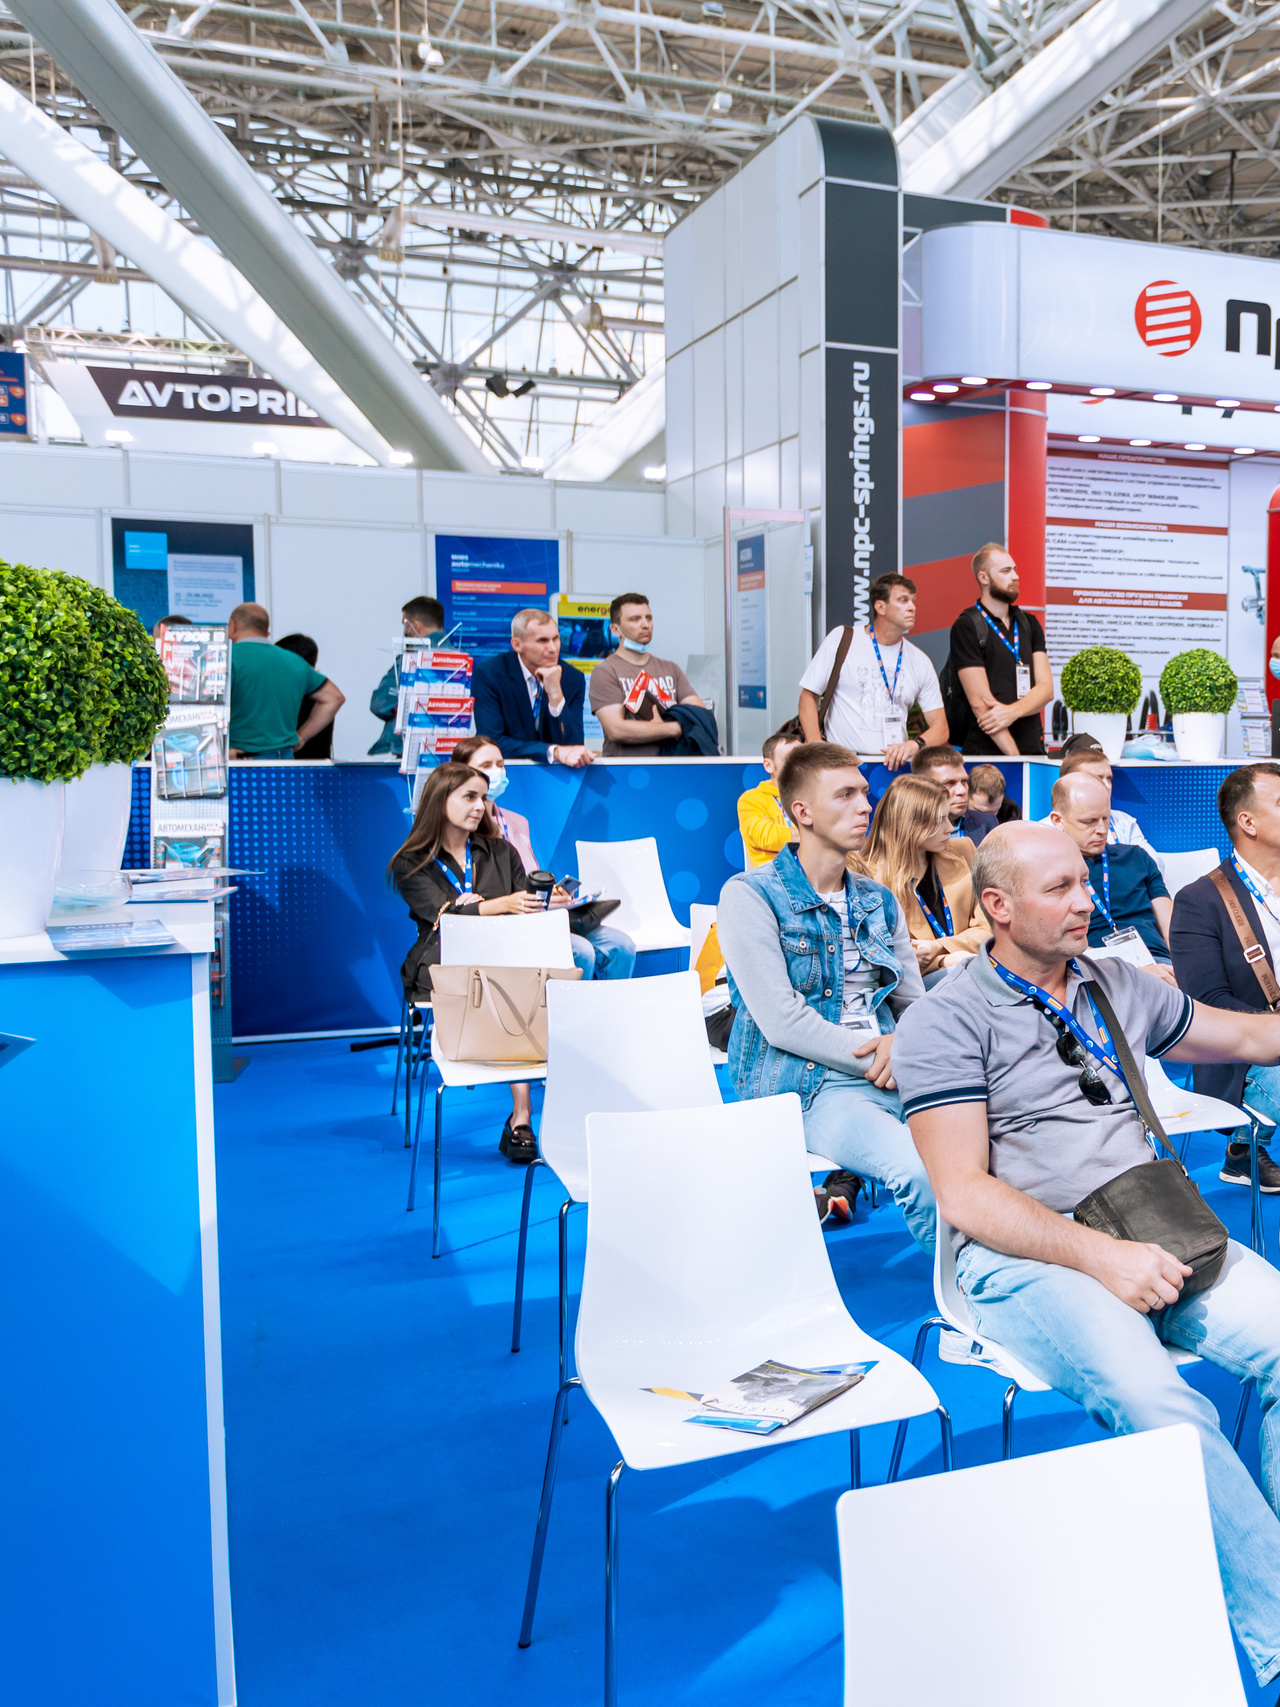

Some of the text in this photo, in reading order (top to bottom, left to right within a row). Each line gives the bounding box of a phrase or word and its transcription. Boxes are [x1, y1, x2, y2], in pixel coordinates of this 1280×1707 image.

[849, 361, 875, 626] ww.npc-springs.ru
[164, 630, 210, 642] КУЗОВ
[1261, 973, 1277, 1000] EFORM
